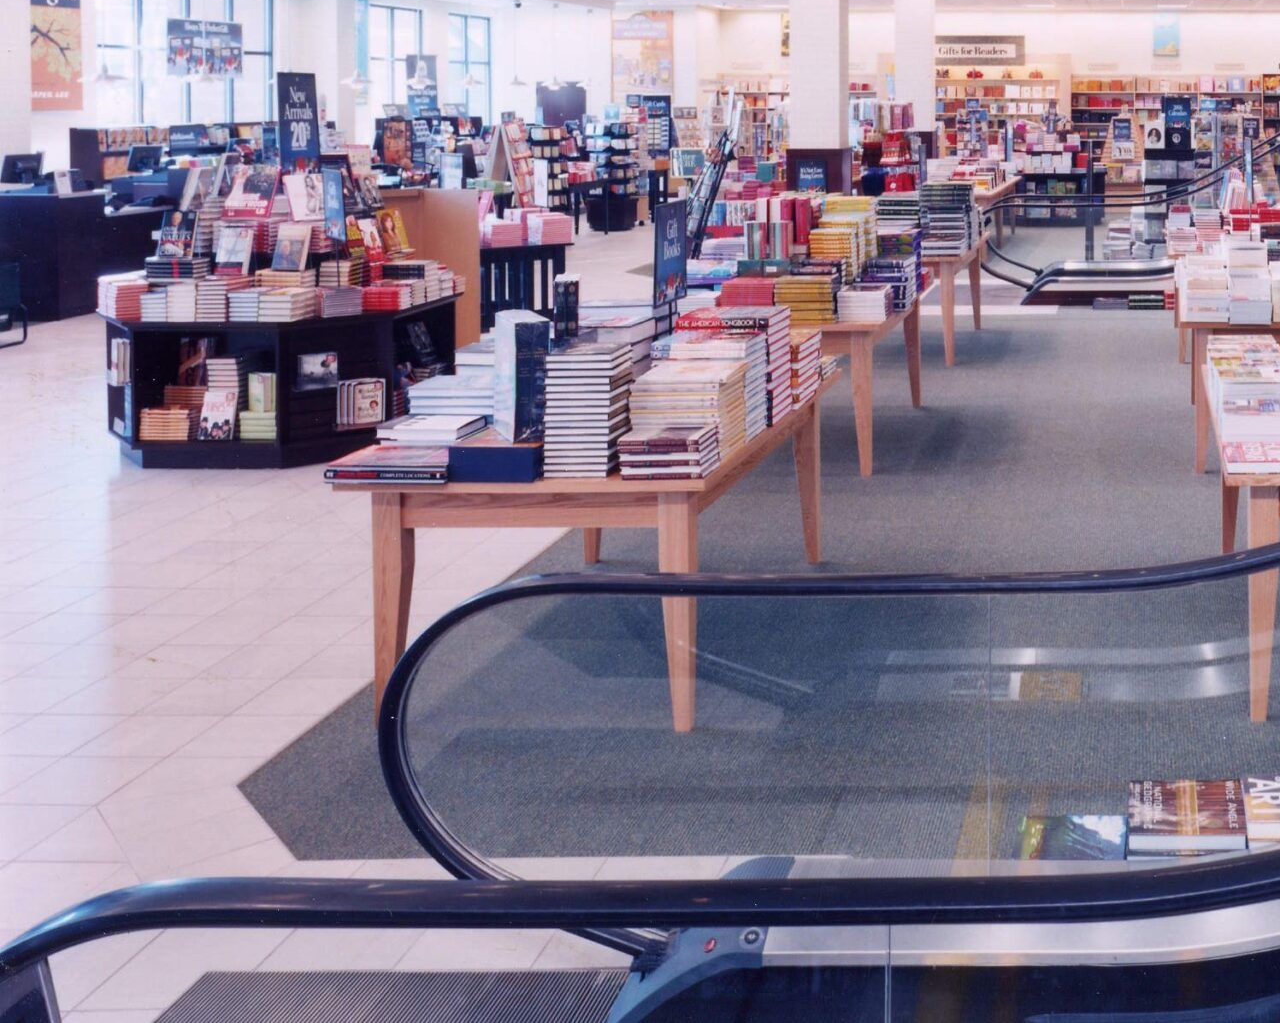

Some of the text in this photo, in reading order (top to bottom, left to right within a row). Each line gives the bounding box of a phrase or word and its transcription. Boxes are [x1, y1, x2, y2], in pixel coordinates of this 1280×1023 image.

[938, 46, 1008, 56] Gifts for Readers
[290, 86, 306, 103] New
[283, 102, 313, 120] Arrivals
[666, 218, 678, 240] Gift
[663, 240, 681, 261] Books
[678, 318, 755, 328] THE AMERICAN SONGBOOK
[1225, 780, 1239, 830] WIDE ANGLE
